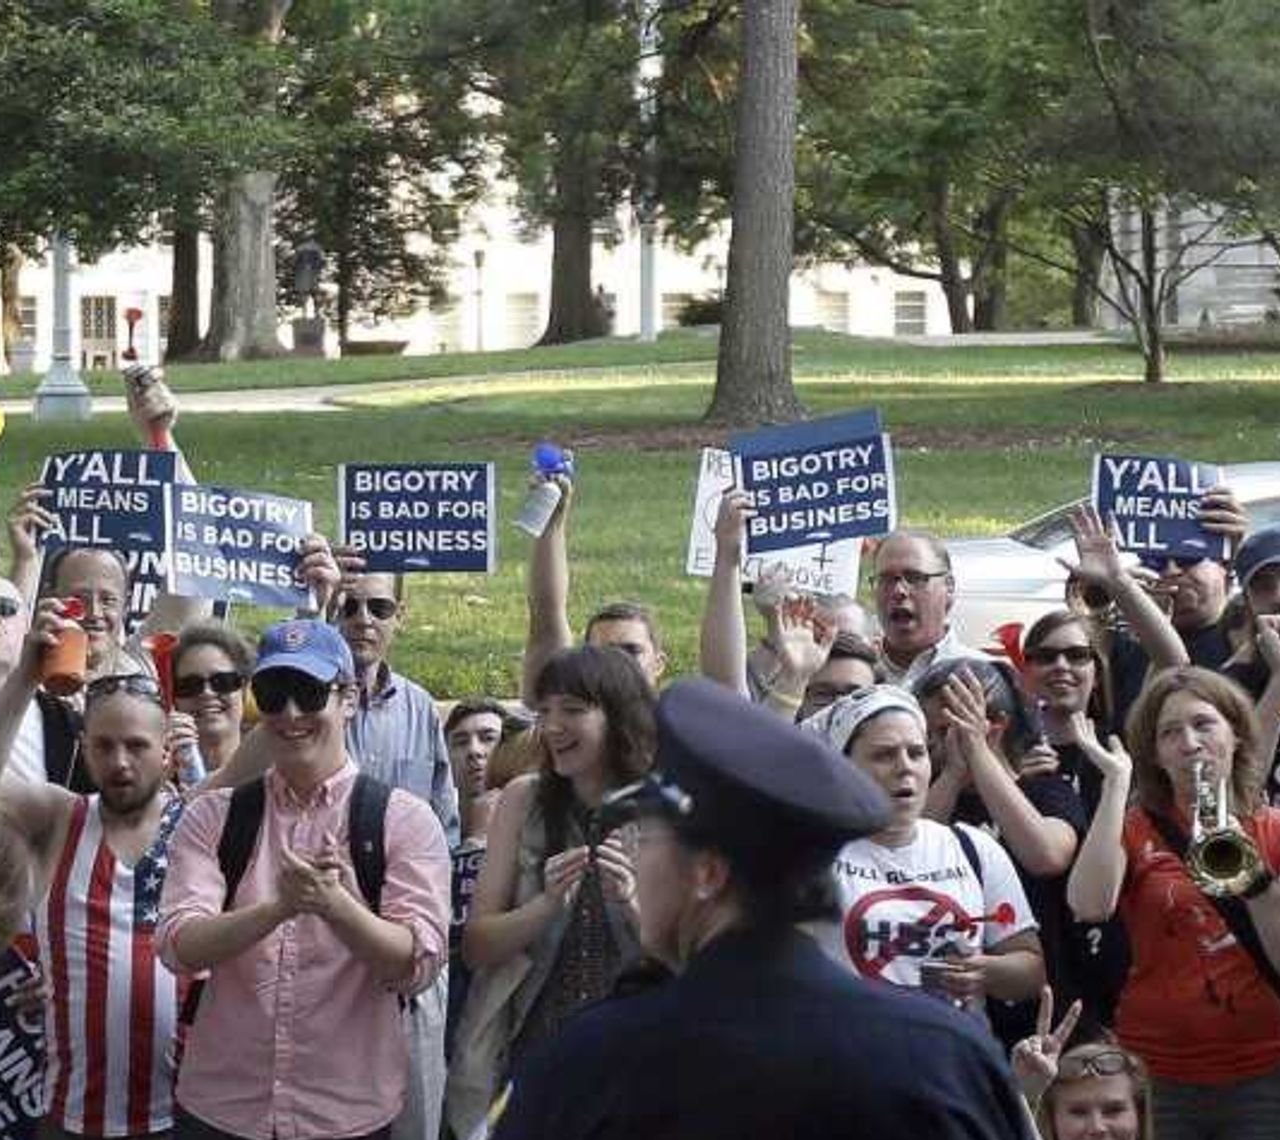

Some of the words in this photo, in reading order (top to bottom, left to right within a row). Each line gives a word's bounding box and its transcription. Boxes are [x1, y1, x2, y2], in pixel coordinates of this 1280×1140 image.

[54, 452, 162, 486] Y'ALL
[751, 444, 874, 481] BIGOTRY
[1104, 458, 1204, 496] Y'ALL
[355, 470, 478, 493] BIGOTRY
[778, 481, 830, 505] BAD
[836, 472, 887, 495] FOR
[56, 486, 150, 512] MEANS
[180, 491, 299, 525] BIGOTRY
[351, 501, 371, 520] IS
[379, 501, 430, 520] BAD
[437, 501, 487, 520] FOR
[176, 521, 197, 541] IS
[203, 525, 254, 548] BAD
[750, 499, 889, 537] BUSINESS
[349, 530, 487, 552] BUSINESS
